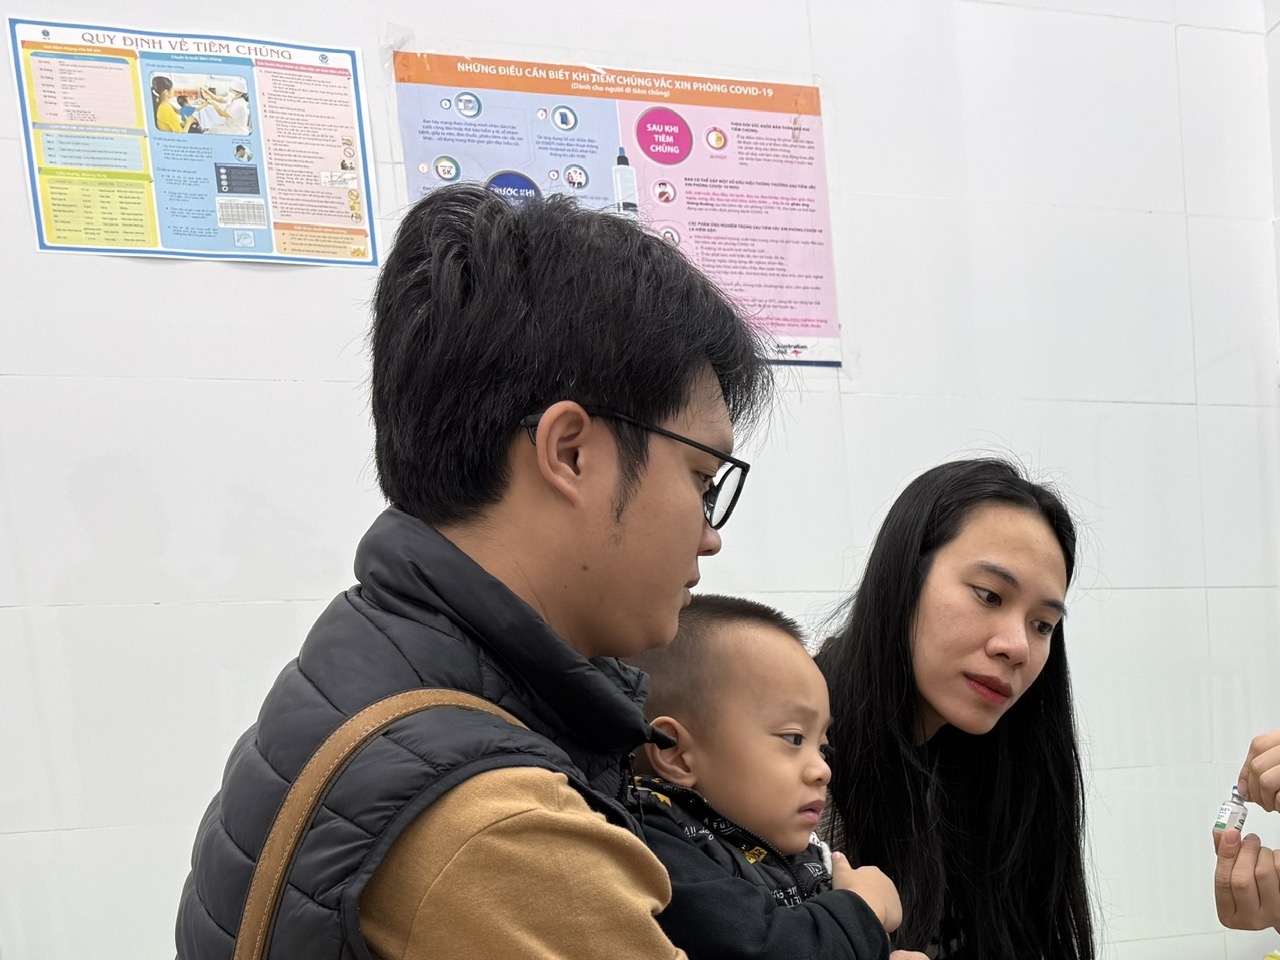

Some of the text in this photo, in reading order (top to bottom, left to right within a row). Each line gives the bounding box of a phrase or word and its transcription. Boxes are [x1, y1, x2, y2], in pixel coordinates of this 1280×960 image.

[81, 32, 292, 60] QUY ĐỊNH VỀ TIÊM CHỦNG
[457, 62, 497, 75] NHỮNG
[498, 65, 523, 77] ĐIỀU
[525, 66, 547, 79] CẦN
[549, 67, 571, 81] BIẾT
[572, 71, 590, 82] KHI
[616, 74, 652, 88] CHỦNG
[653, 77, 673, 89] VẮC
[674, 80, 692, 91] XIN
[692, 81, 728, 94] PHÒNG
[729, 85, 774, 97] COVID-19
[646, 123, 679, 134] SAU KHI
[654, 133, 674, 144] TIÊM
[649, 143, 680, 155] CHỦNG
